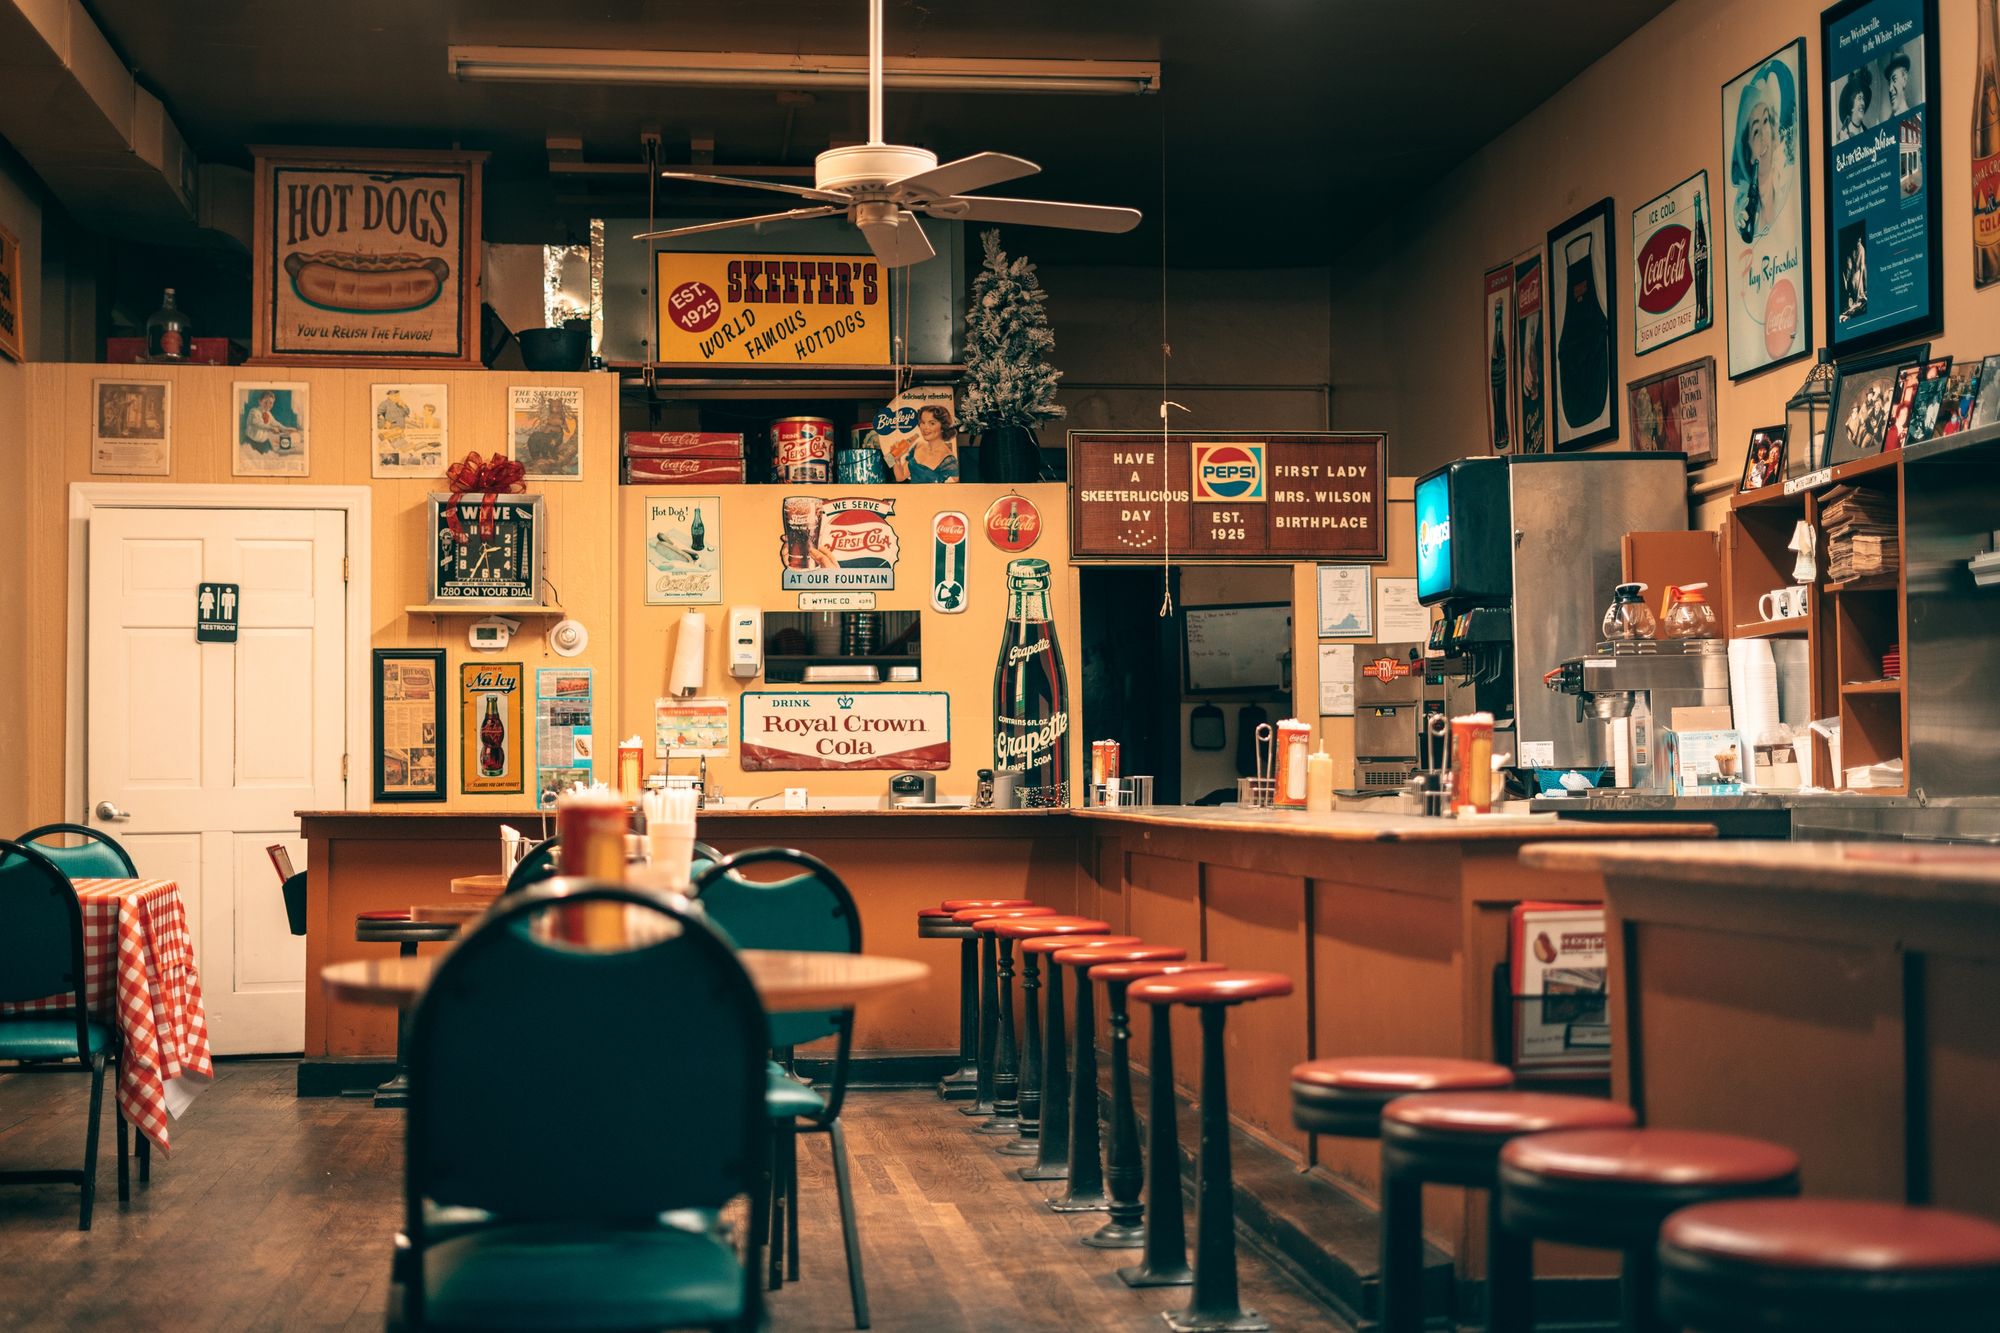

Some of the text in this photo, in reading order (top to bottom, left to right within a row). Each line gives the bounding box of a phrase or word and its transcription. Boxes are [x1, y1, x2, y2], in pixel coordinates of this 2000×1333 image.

[1840, 17, 1880, 48] From Wytheville
[1875, 30, 1893, 46] White
[1894, 20, 1913, 36] House
[287, 184, 447, 248] HOT DOGS
[1648, 201, 1676, 225] ICE COLD
[1761, 246, 1798, 289] Refreshed
[727, 260, 878, 305] SKEETER'S
[670, 282, 706, 310] EST.
[681, 299, 720, 328] 1925
[297, 323, 433, 342] YOU'LL RELISH THE FLAVOR!
[699, 308, 756, 359] WORLD
[1641, 311, 1692, 342] SIGN OF GOOD TASTE
[744, 310, 807, 359] FAMOUS
[1680, 371, 1699, 391] Royal
[1680, 389, 1702, 406] Crown
[1681, 404, 1697, 421] Cola
[1113, 453, 1155, 465] HAVE
[1130, 471, 1141, 483] A
[1203, 465, 1256, 479] PEPSI
[1275, 465, 1367, 478] FIRST LADY
[1080, 490, 1189, 503] SKEETERLICIOUS
[1274, 491, 1371, 503] MRS. WILSON
[833, 500, 880, 511] WE SERVE
[652, 506, 666, 521] Hot
[1121, 510, 1152, 522] DAY
[1212, 511, 1245, 524] EST.
[1275, 516, 1368, 528] BIRTHPLACE
[504, 533, 512, 544] 2
[1210, 528, 1246, 540] 1925
[460, 546, 468, 556] 9
[503, 547, 511, 557] 3
[459, 560, 467, 570] 8
[503, 560, 511, 570] 4
[481, 568, 489, 578] 6
[493, 568, 501, 578] 5
[790, 574, 888, 584] AT OUR FOUNTAIN
[441, 587, 532, 597] 1280 ON YOUR DIAL
[1009, 638, 1050, 666] Grapette
[1380, 660, 1393, 677] FRY
[466, 672, 518, 694] Nu Icy
[772, 699, 811, 708] DRINK
[762, 714, 927, 737] Royal Crown
[815, 738, 876, 756] Cola
[998, 711, 1067, 770] Grapette
[1033, 753, 1052, 767] SODA
